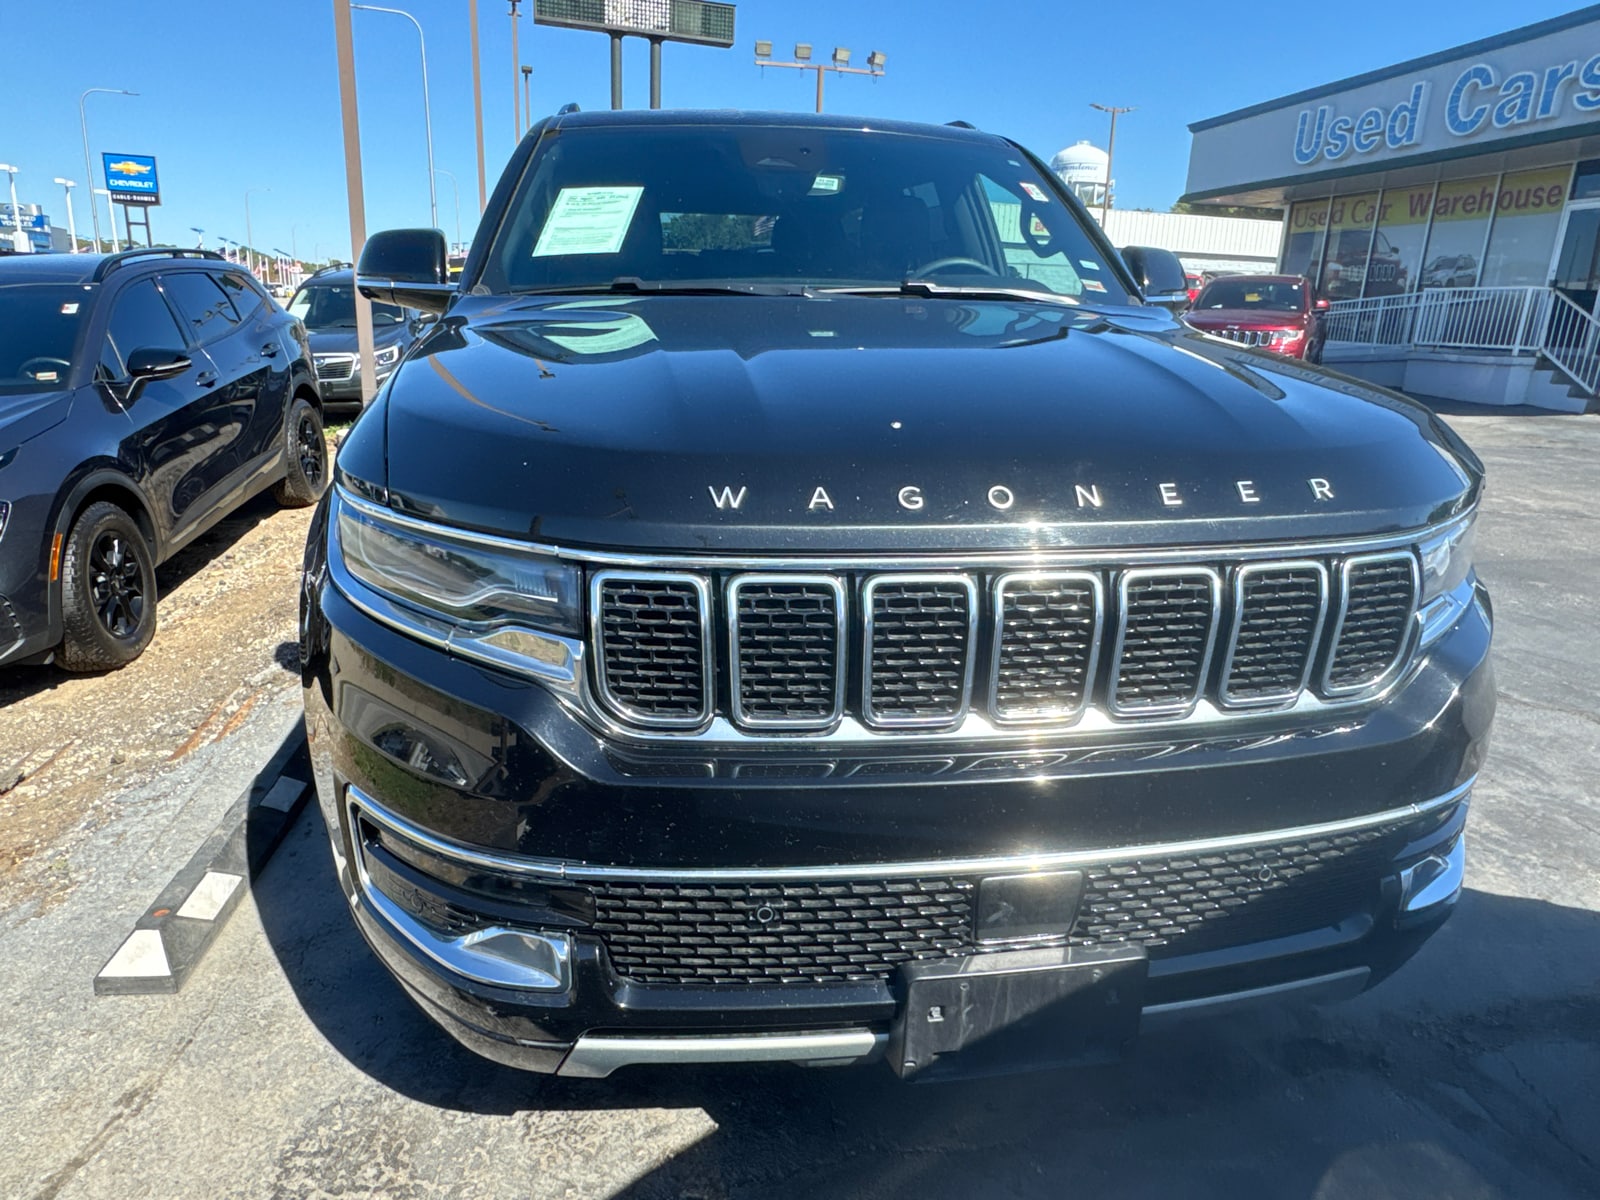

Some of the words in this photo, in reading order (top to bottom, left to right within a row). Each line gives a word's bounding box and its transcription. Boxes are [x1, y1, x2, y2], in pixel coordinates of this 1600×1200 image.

[1294, 80, 1431, 165] Used
[1445, 53, 1600, 136] Cars
[109, 179, 154, 189] CHEVROLET
[1294, 201, 1346, 228] Used
[1351, 199, 1392, 224] Car
[1408, 184, 1564, 218] Warehouse
[708, 476, 1334, 510] WAGONEER
